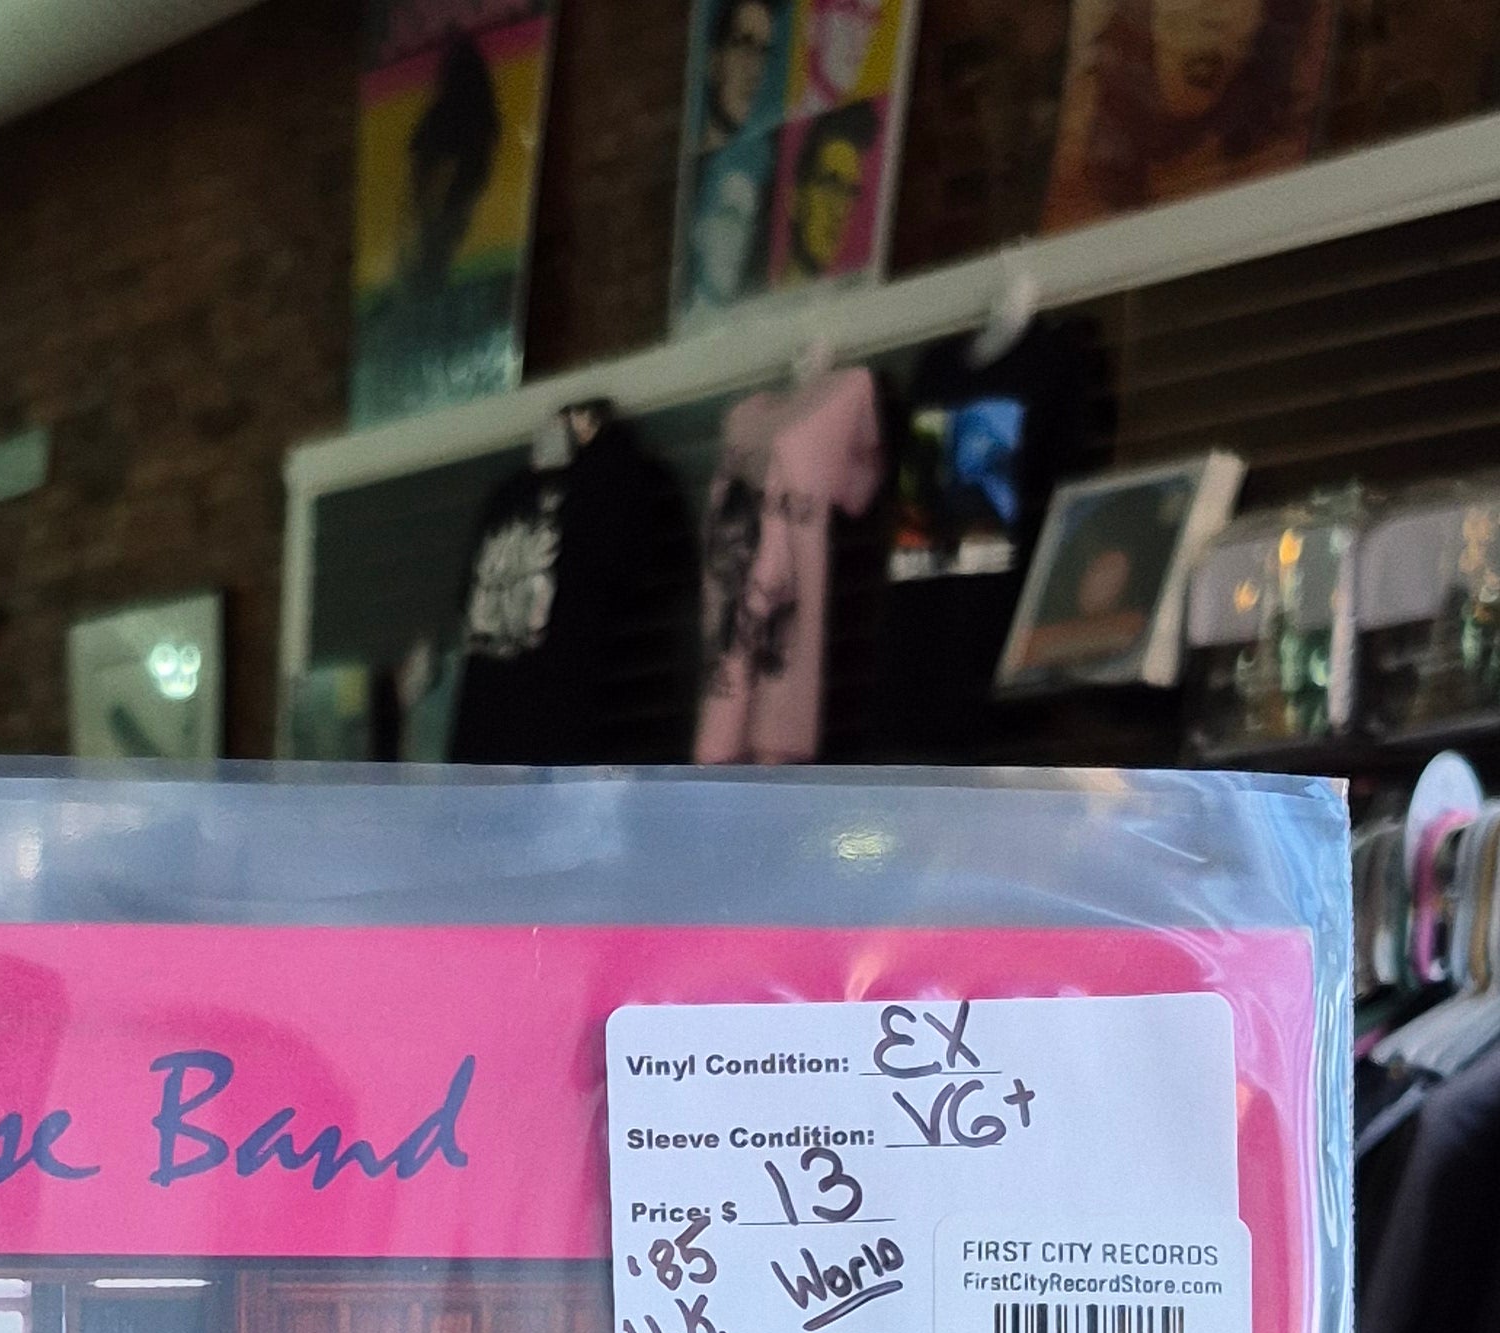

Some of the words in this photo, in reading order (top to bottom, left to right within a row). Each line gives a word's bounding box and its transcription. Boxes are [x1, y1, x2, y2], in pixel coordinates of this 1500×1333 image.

[626, 1055, 695, 1081] Vinyl
[706, 1054, 850, 1076] Condition:
[873, 1000, 980, 1078] EX
[149, 1050, 475, 1191] Band
[627, 1129, 719, 1150] Sleeve
[729, 1127, 875, 1148] Condition:
[893, 1078, 1035, 1147] VG+
[631, 1203, 712, 1223] Price:
[721, 1202, 737, 1223] $
[764, 1147, 863, 1225] 13
[771, 1238, 904, 1309] World
[963, 1241, 1031, 1262] FIRST
[1041, 1242, 1092, 1263] CITY
[1102, 1244, 1219, 1265] RECORDS
[963, 1273, 1222, 1295] FirstCityRecordStore.com
